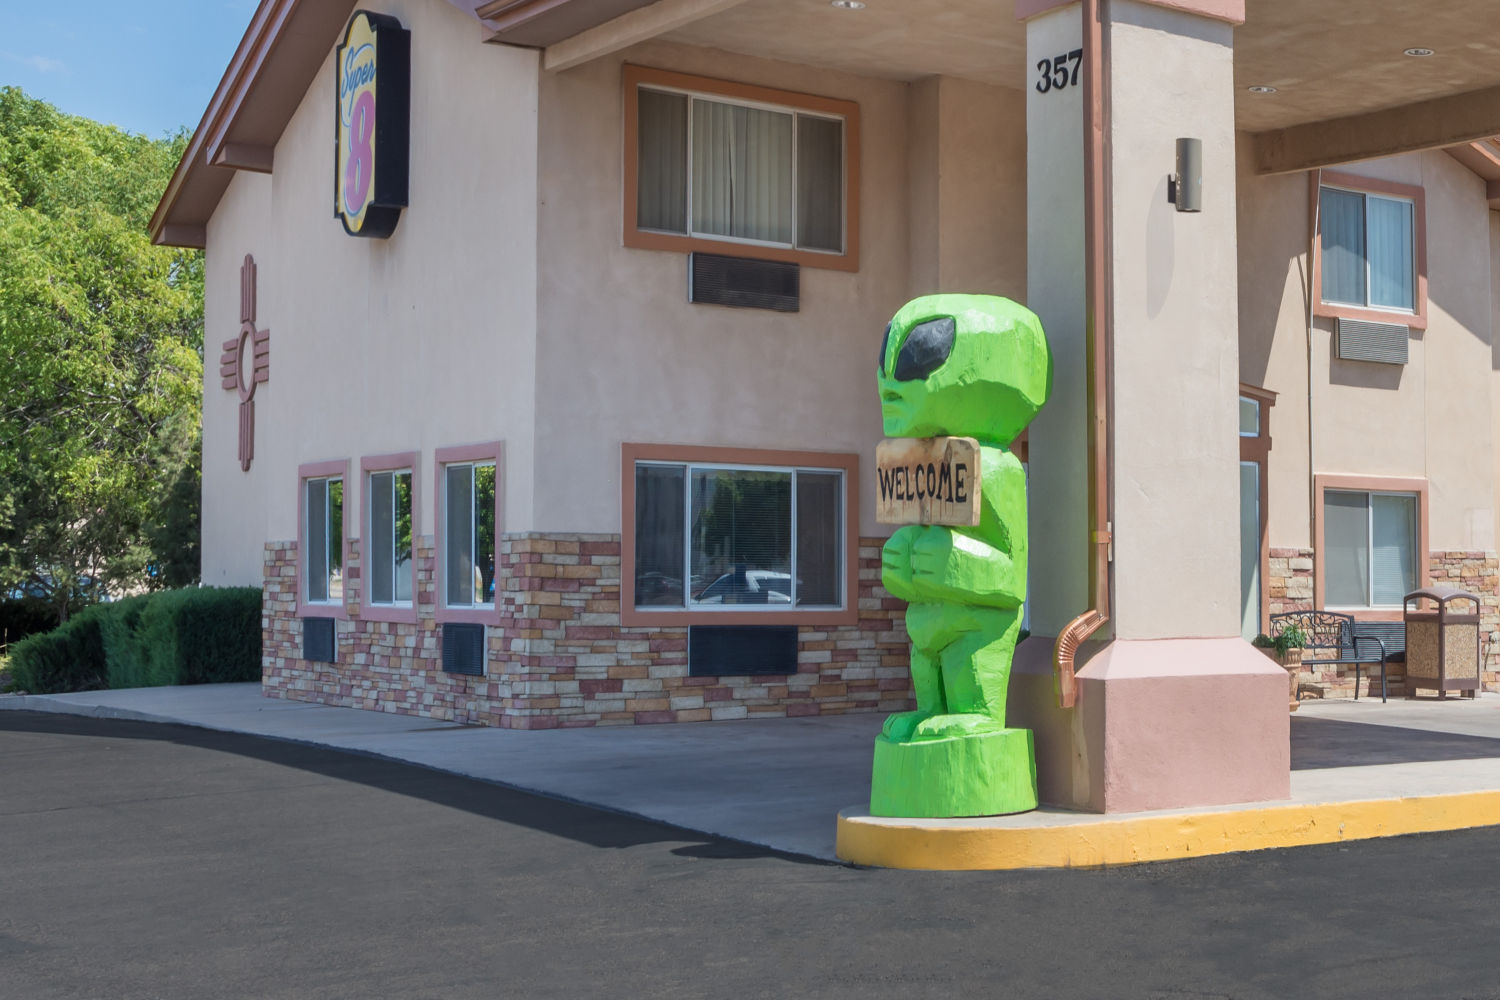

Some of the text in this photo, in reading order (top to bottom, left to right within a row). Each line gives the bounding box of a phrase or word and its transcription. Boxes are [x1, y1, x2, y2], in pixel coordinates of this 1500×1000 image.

[341, 43, 376, 124] Super
[1036, 48, 1083, 94] 357
[344, 90, 375, 217] 8
[877, 462, 968, 503] WELCOME
